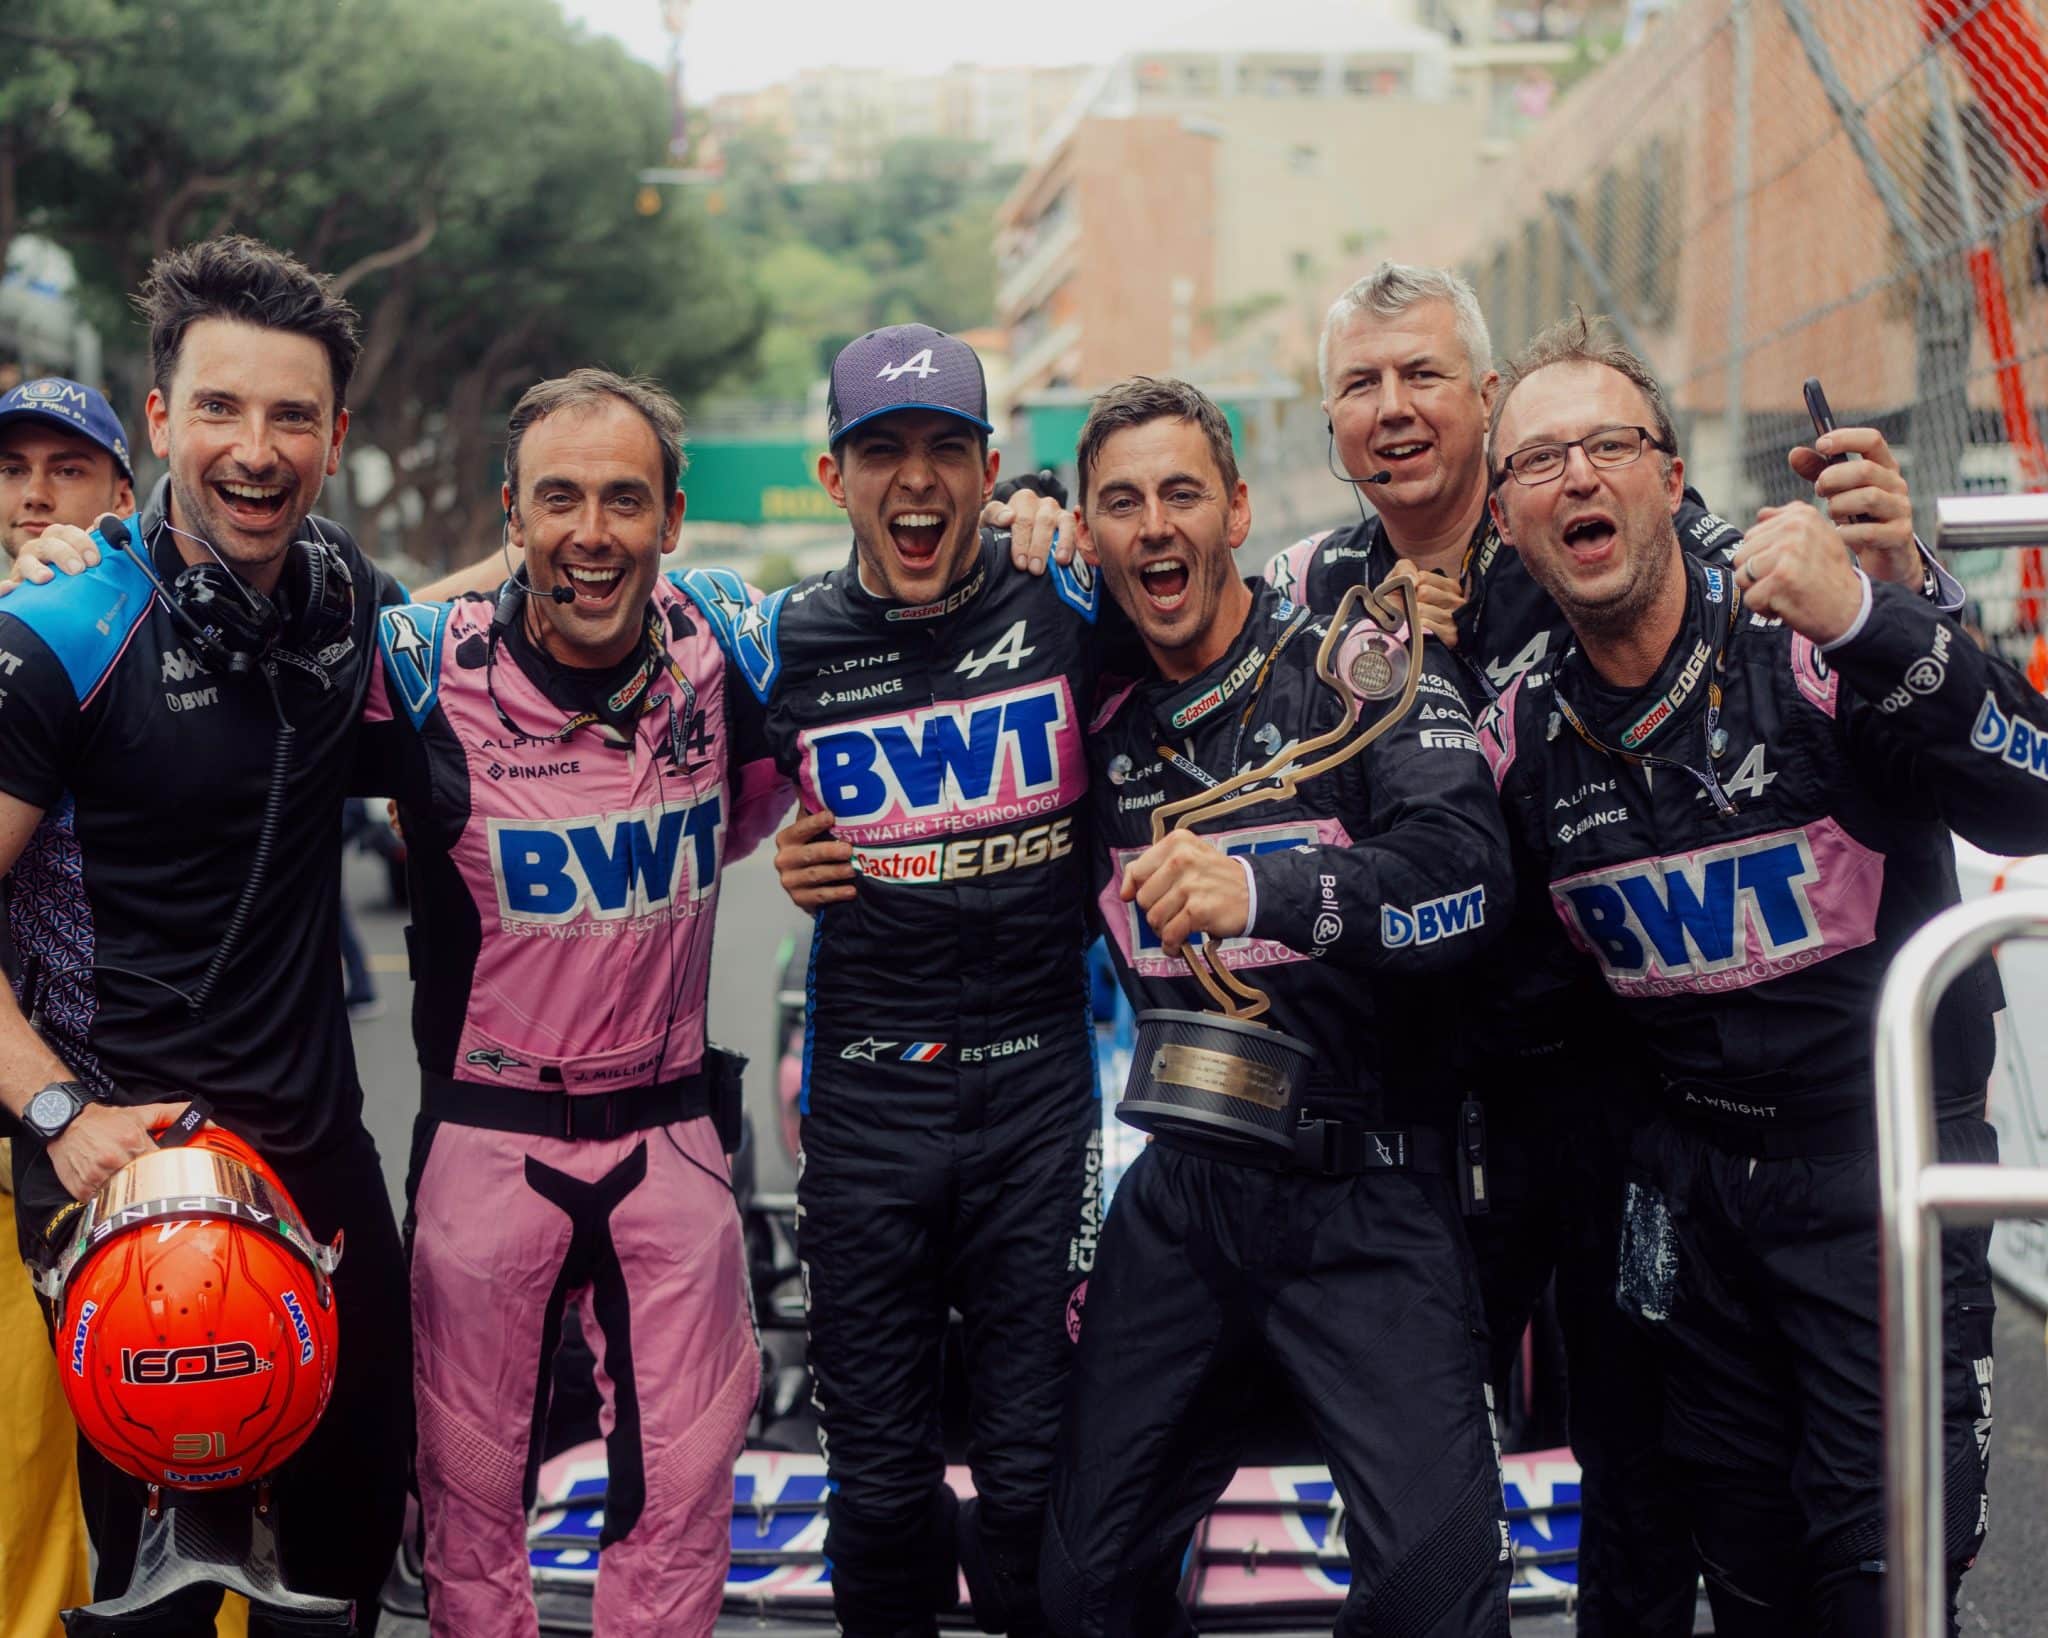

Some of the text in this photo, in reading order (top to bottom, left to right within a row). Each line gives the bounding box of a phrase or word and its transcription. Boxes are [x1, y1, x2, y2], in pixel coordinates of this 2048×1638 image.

[817, 652, 900, 677] ALPINE
[1931, 622, 1952, 664] Bell
[180, 687, 219, 711] BWT
[836, 679, 904, 702] BINANCE
[1185, 646, 1266, 722] Castrol EDGE
[1633, 638, 1713, 741] Castrol EDGE
[810, 692, 1060, 819] BWT
[1419, 728, 1480, 752] PIRE
[2007, 718, 2048, 777] BW
[509, 761, 581, 779] BINANCE
[863, 819, 927, 841] WATER
[932, 791, 1061, 831] TECHNOLOGY
[497, 796, 723, 916] BWT
[858, 817, 1074, 881] Castrol EDGE
[1319, 874, 1340, 911] Bell
[1415, 885, 1484, 944] BWT
[1565, 842, 1807, 973] BWT
[501, 919, 543, 938] BEST
[549, 921, 616, 940] WATER
[960, 1034, 1040, 1062] ESTEBAN
[181, 1110, 201, 1131] 2023
[1703, 1095, 1777, 1118] WRIGHT
[94, 1196, 272, 1243] ALPINE
[1078, 1128, 1101, 1273] CHANGE
[281, 1290, 313, 1344] BWT
[72, 1322, 89, 1377] BWT
[189, 1466, 242, 1483] BWT
